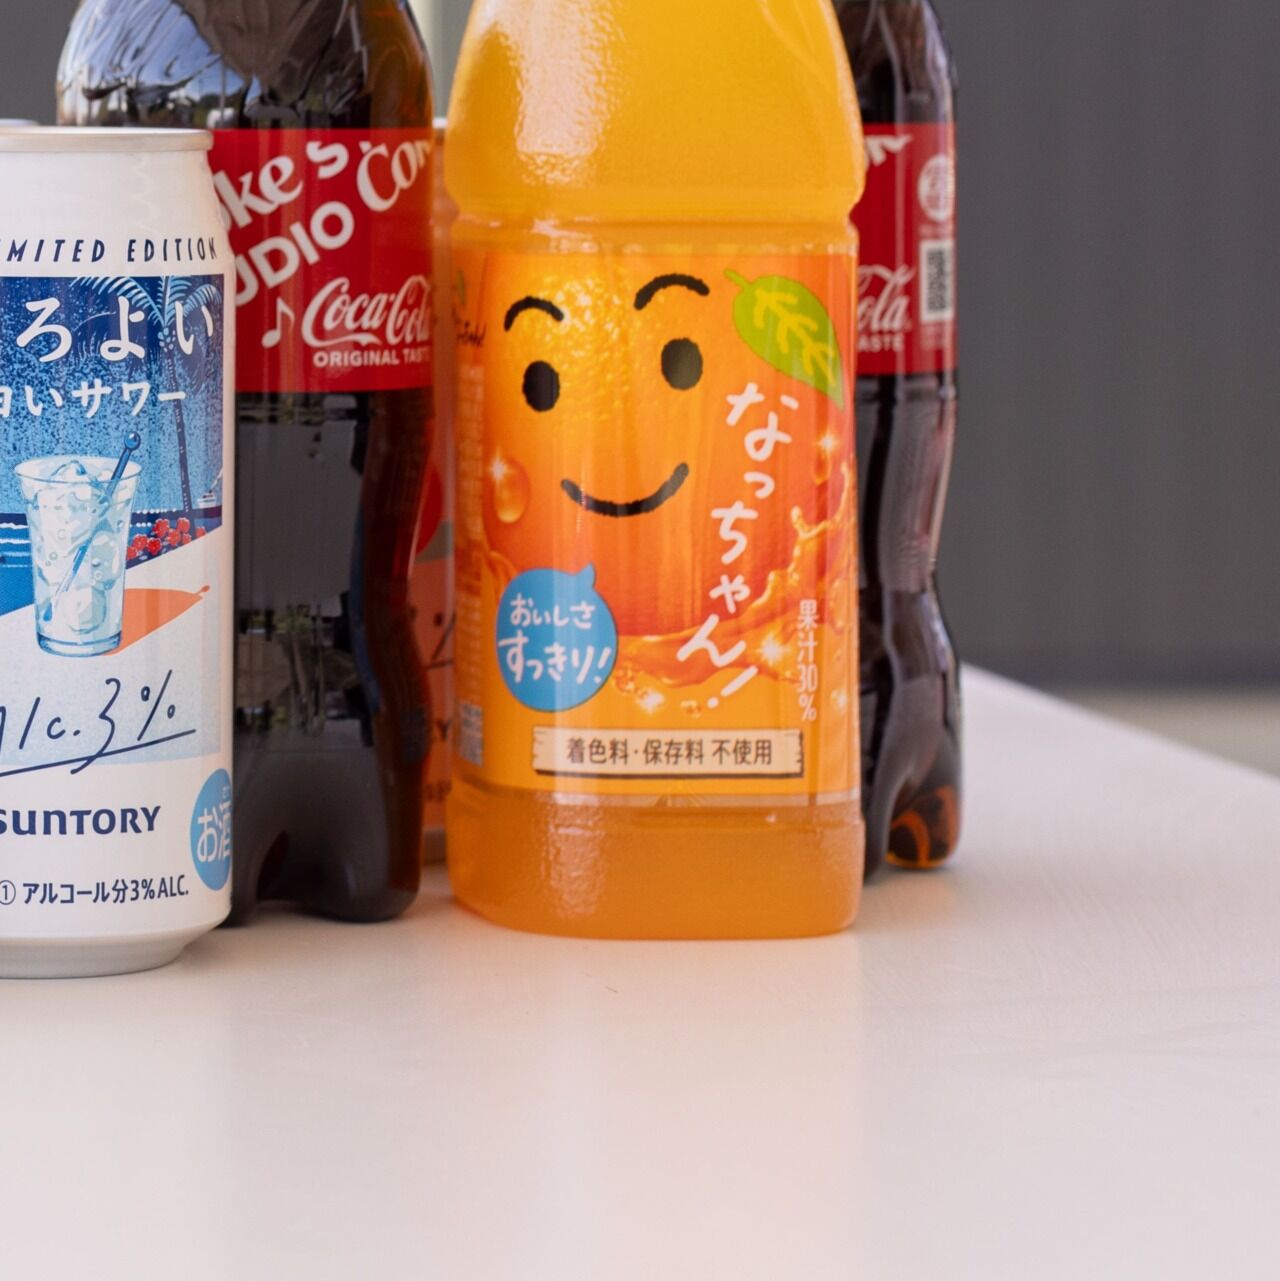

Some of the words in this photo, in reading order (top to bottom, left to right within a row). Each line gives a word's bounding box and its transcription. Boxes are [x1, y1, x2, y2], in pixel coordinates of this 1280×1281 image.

[127, 236, 218, 263] EDITION
[313, 349, 400, 368] ORIGINAL
[510, 592, 596, 629] おいしさ
[498, 629, 612, 685] すっきり!
[797, 598, 819, 722] 果汁30%
[711, 738, 773, 766] 不使用
